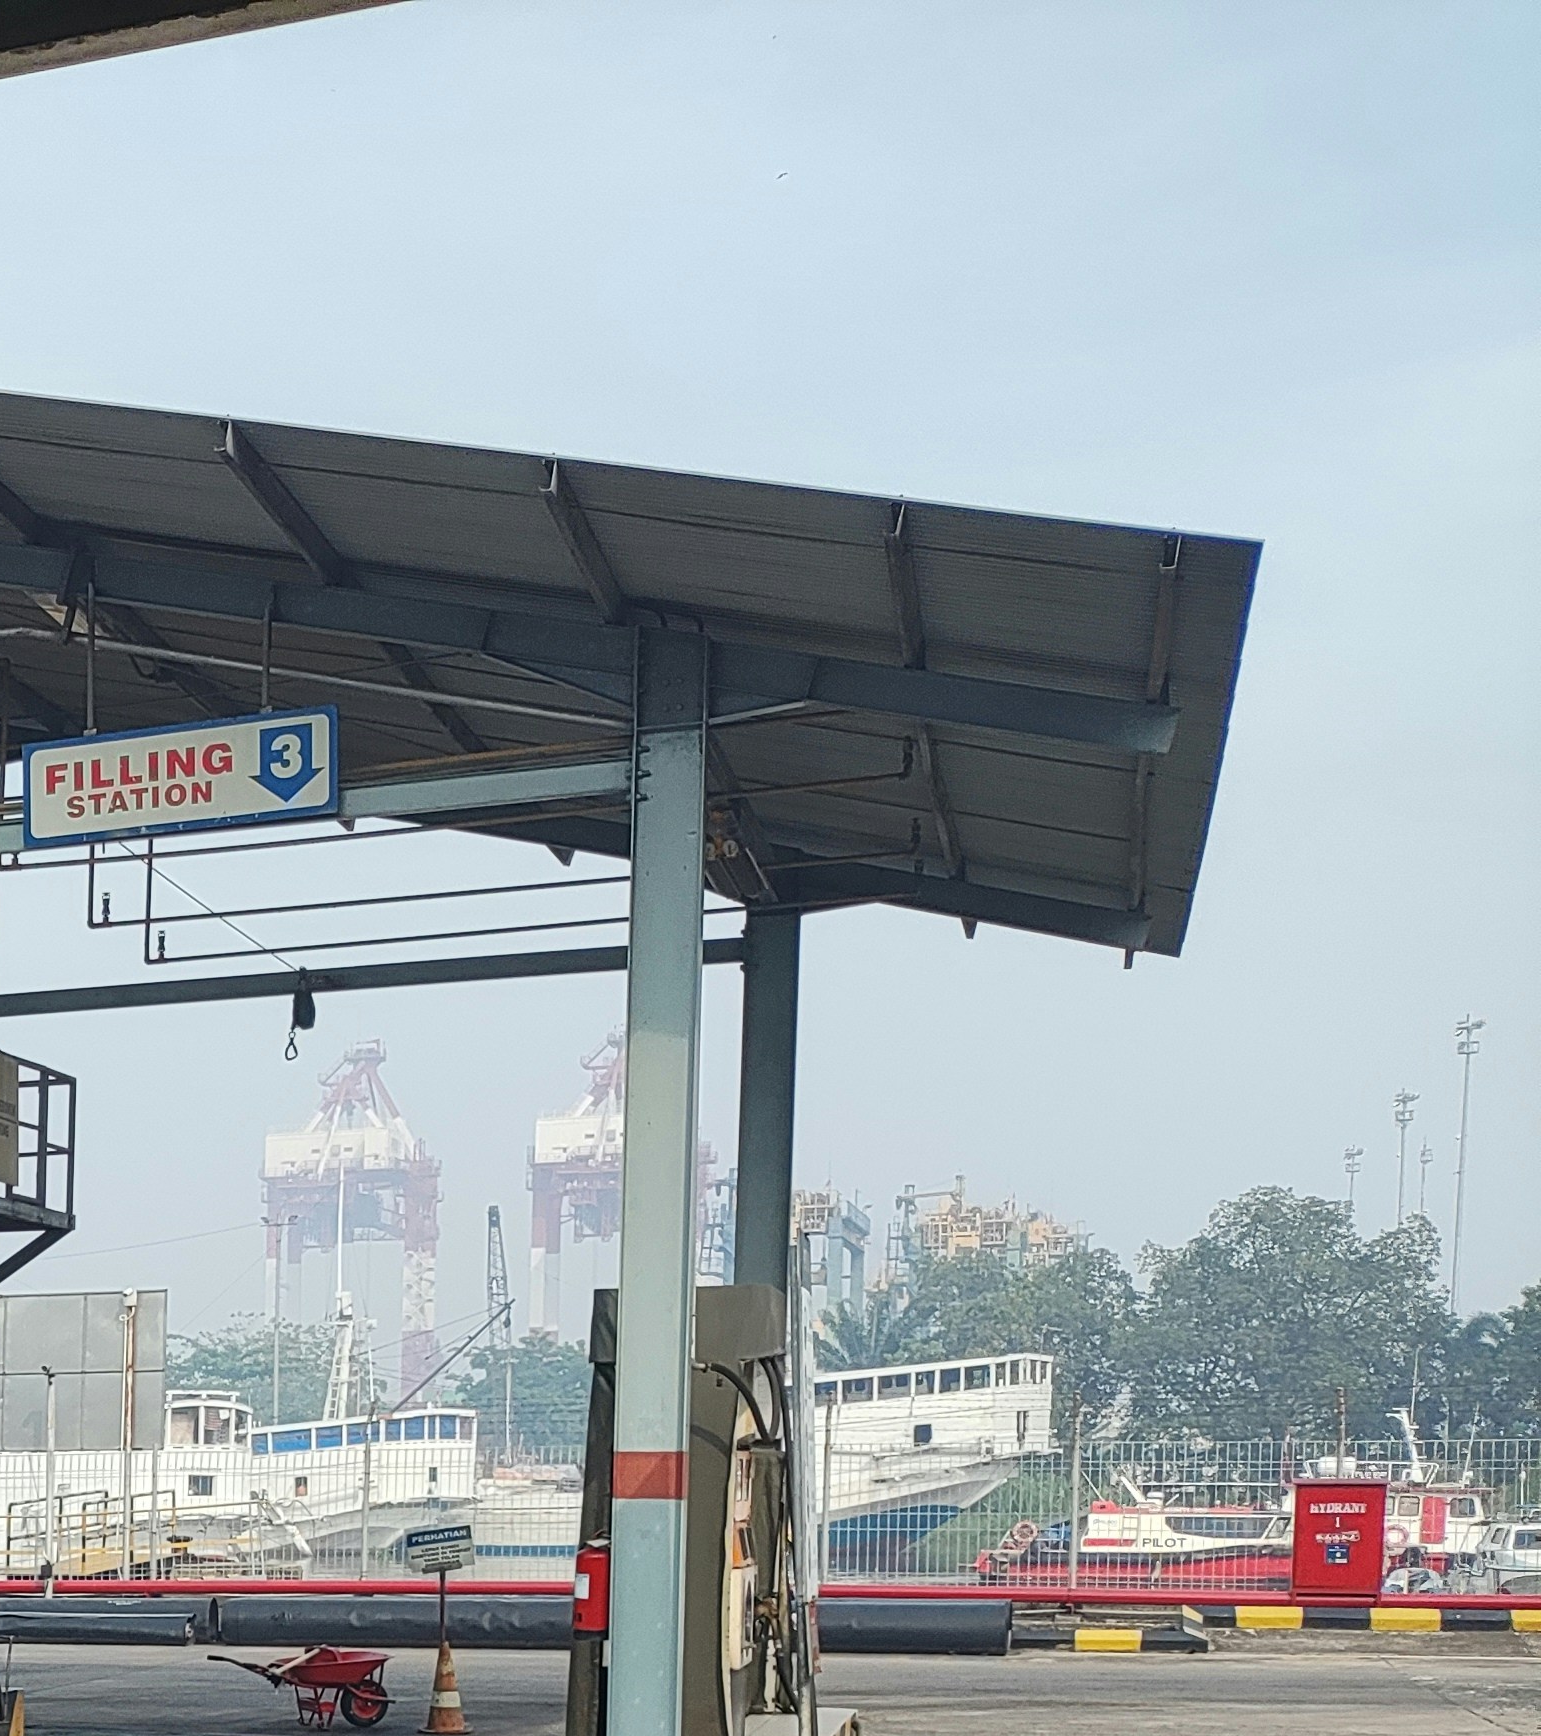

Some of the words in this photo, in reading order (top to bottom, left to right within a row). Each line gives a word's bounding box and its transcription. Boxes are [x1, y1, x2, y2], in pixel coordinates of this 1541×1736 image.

[45, 743, 233, 795] FILLING
[269, 733, 303, 779] 3
[66, 781, 213, 819] STATION
[1309, 1502, 1367, 1514] HYDRANT
[411, 1529, 467, 1544] PERHATIAN
[1142, 1537, 1187, 1548] PILOT
